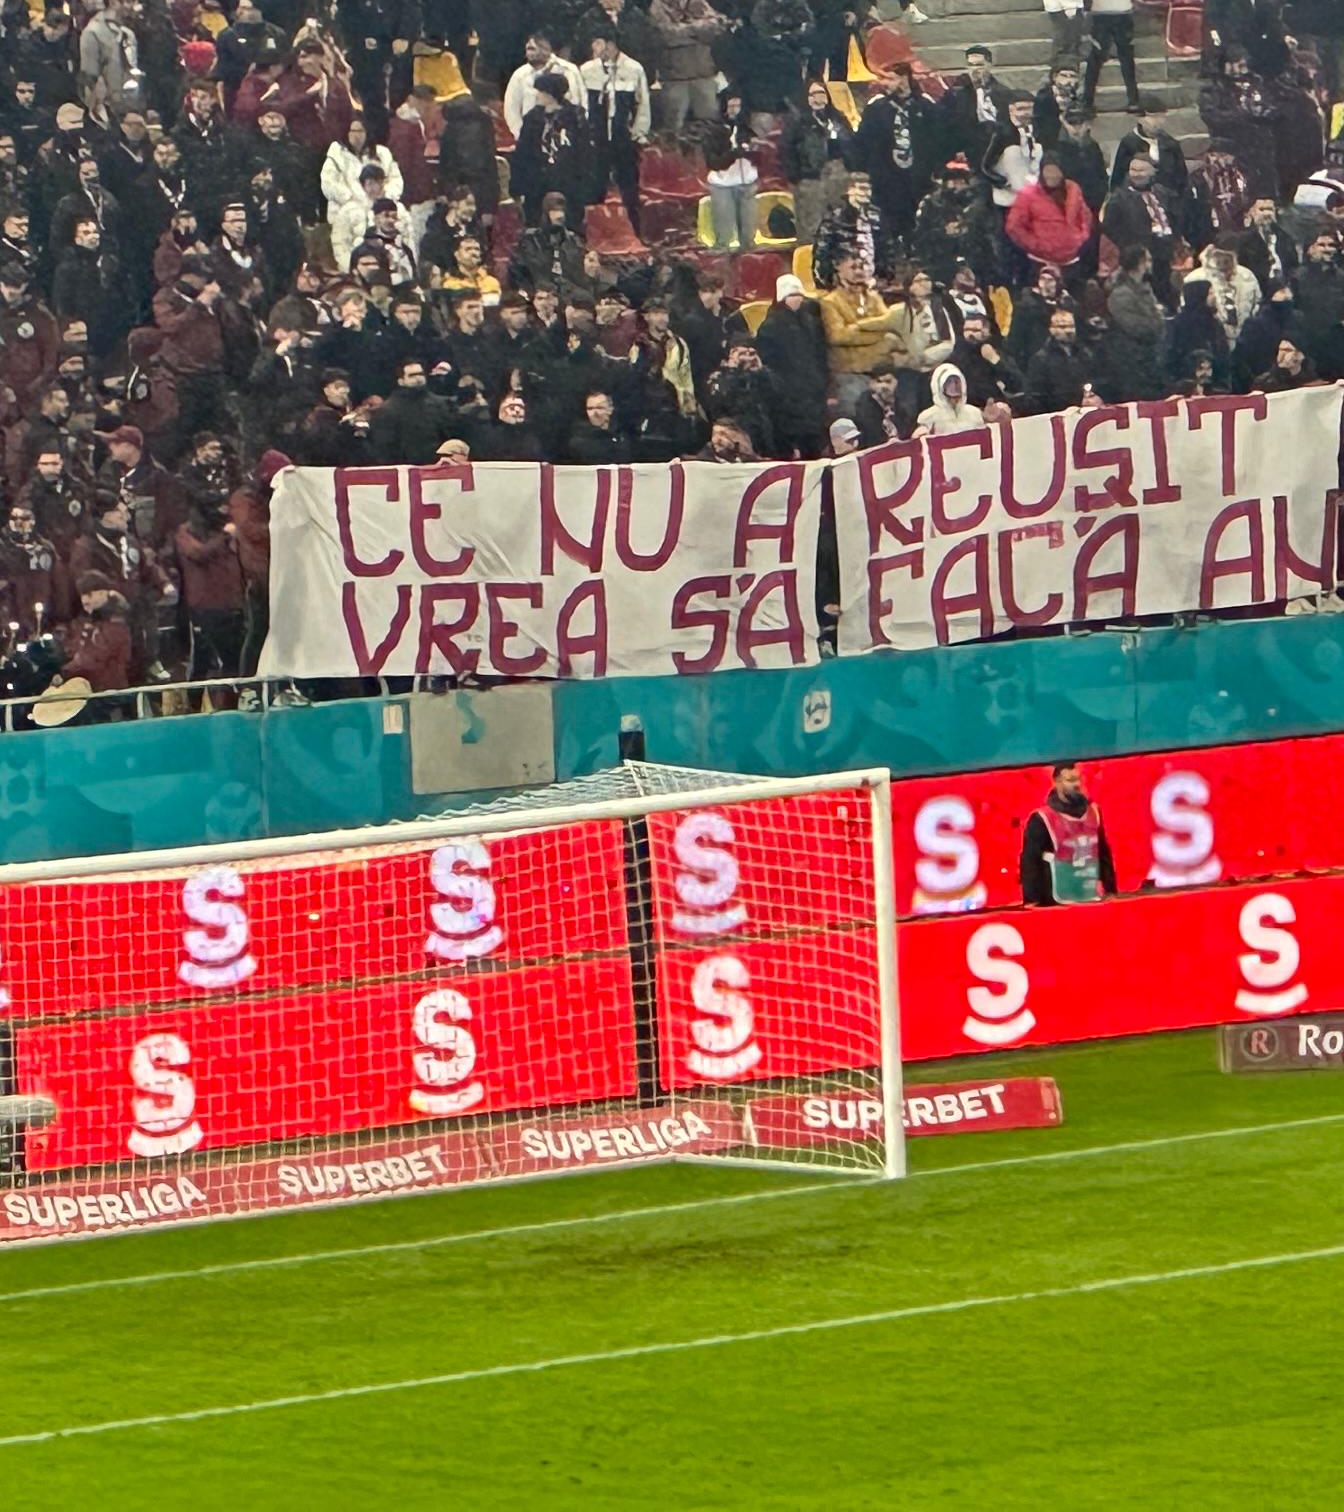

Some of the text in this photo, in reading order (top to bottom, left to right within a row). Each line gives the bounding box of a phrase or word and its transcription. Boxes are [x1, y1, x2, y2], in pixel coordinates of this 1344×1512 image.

[334, 464, 475, 577] CE
[540, 462, 686, 575] NU
[733, 463, 806, 568] A
[342, 579, 608, 677] VREA
[674, 813, 739, 906] S
[915, 797, 978, 891] S
[1152, 772, 1212, 864] S
[183, 867, 249, 962] S
[430, 840, 496, 934] S
[967, 923, 1029, 1018] S
[1239, 894, 1299, 986] S
[412, 988, 476, 1086] S
[691, 954, 755, 1052] S
[131, 1034, 195, 1129] S
[4, 1177, 207, 1228] SUPERLIGA
[277, 1144, 450, 1196] SUPERBET
[519, 1110, 712, 1161] SUPERLIGA
